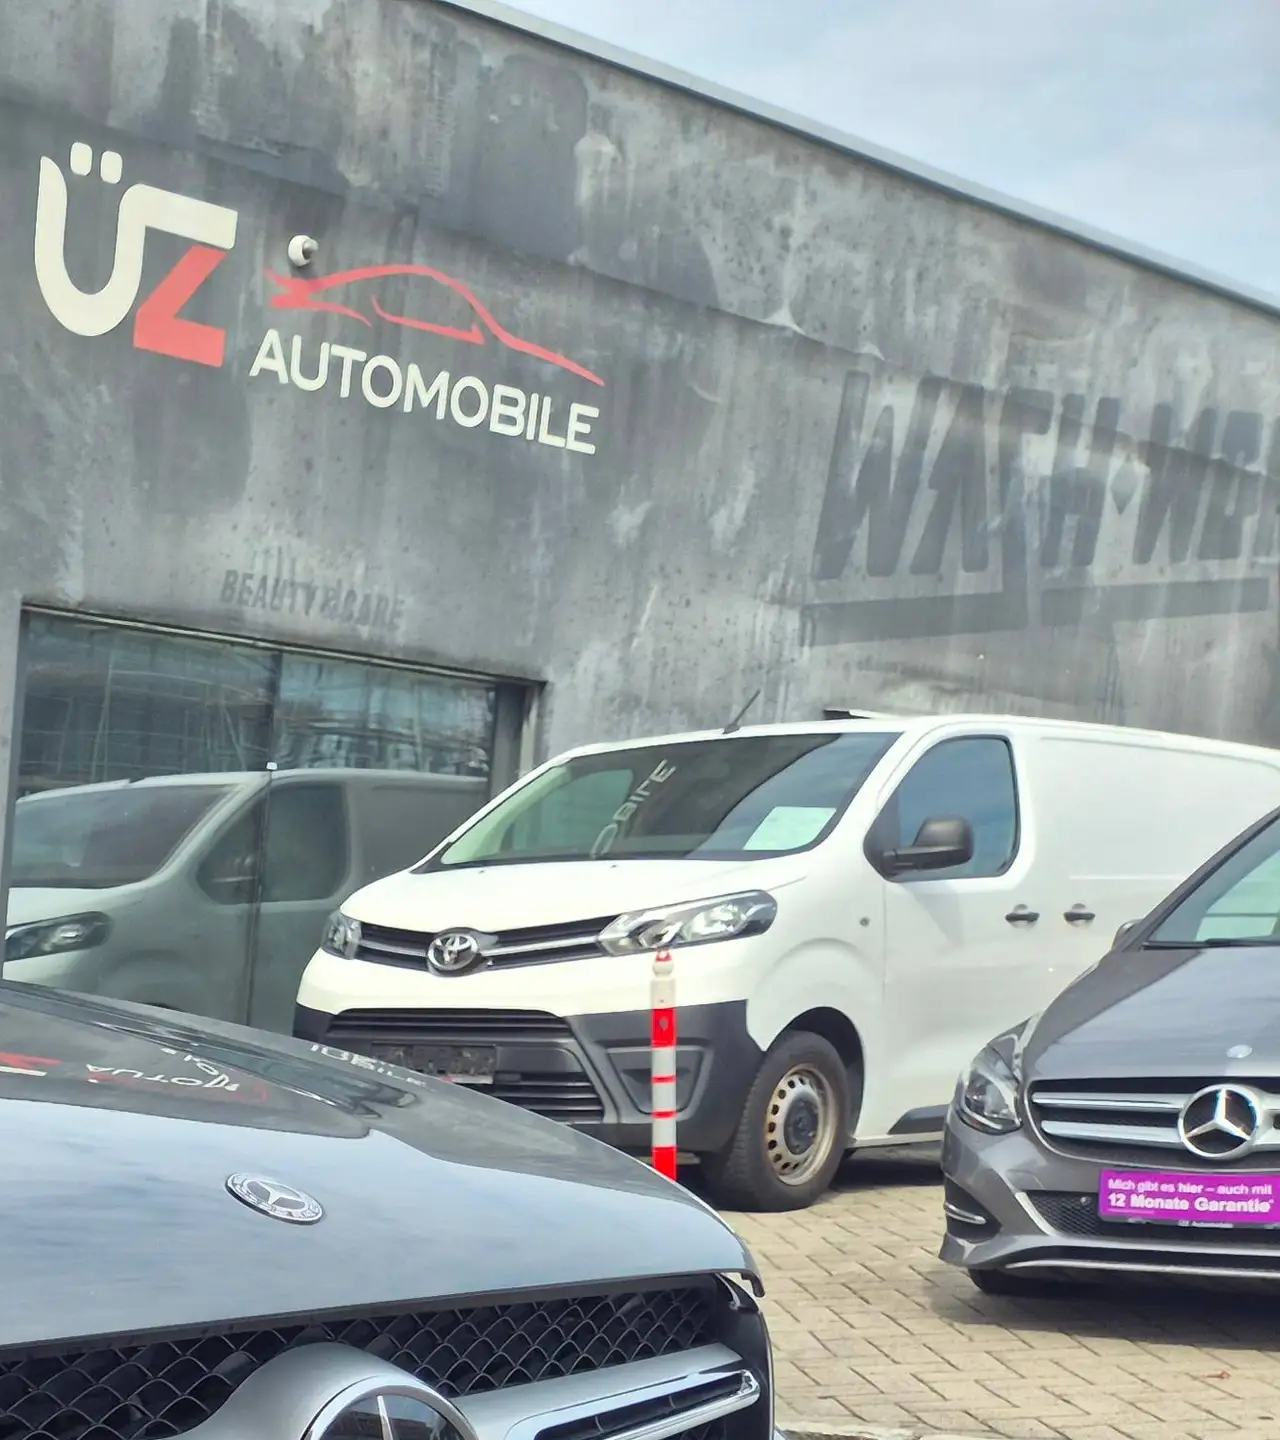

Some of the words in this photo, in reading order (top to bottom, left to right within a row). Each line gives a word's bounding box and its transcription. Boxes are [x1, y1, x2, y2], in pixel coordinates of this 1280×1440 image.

[34, 141, 239, 368] ÜZ
[249, 328, 601, 456] AUTOMOBILE
[1108, 1178, 1136, 1190] Mich
[1160, 1183, 1175, 1193] es
[1178, 1182, 1204, 1194] hier
[1216, 1184, 1249, 1195] auch
[1251, 1184, 1272, 1195] mit
[1108, 1192, 1127, 1207] 12
[1130, 1193, 1190, 1210] Monate
